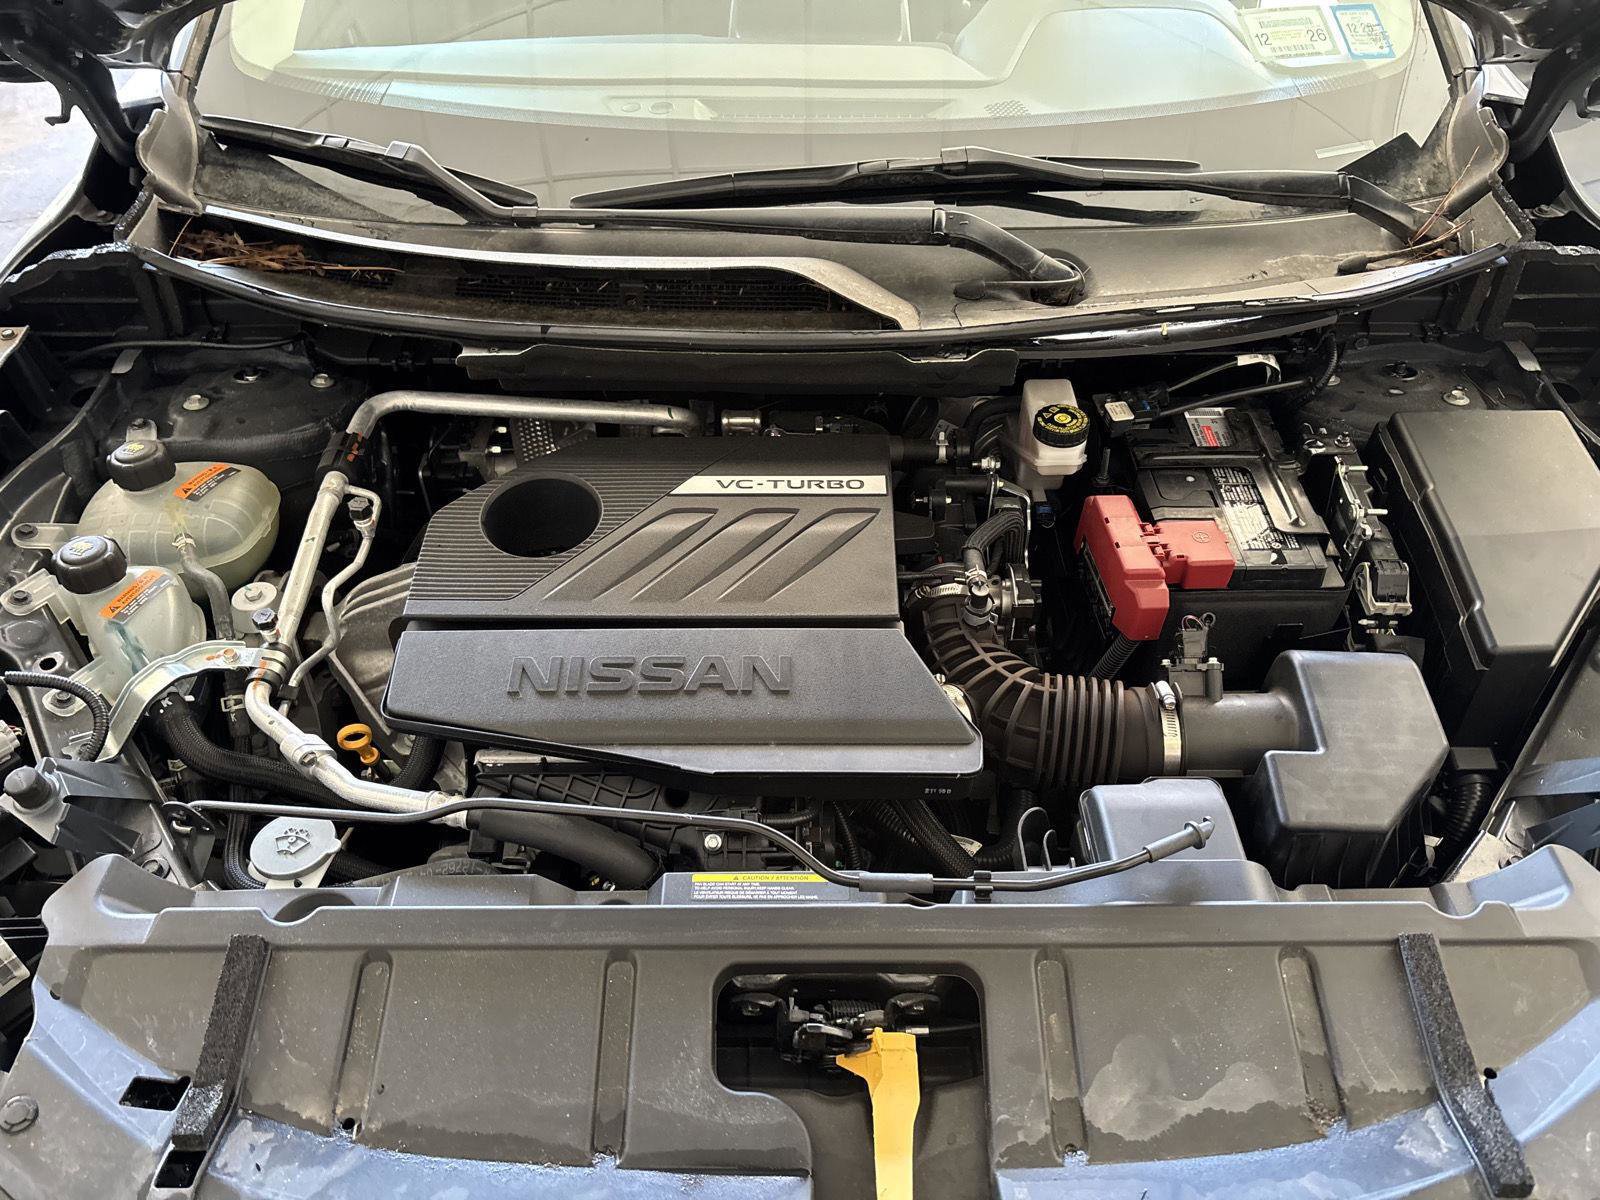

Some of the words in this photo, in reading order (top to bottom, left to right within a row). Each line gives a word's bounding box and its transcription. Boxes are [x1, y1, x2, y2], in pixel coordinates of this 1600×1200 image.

[1254, 32, 1272, 46] 12
[1306, 28, 1327, 42] 26
[716, 479, 865, 489] VC-TURBO
[507, 654, 793, 695] NISSAN
